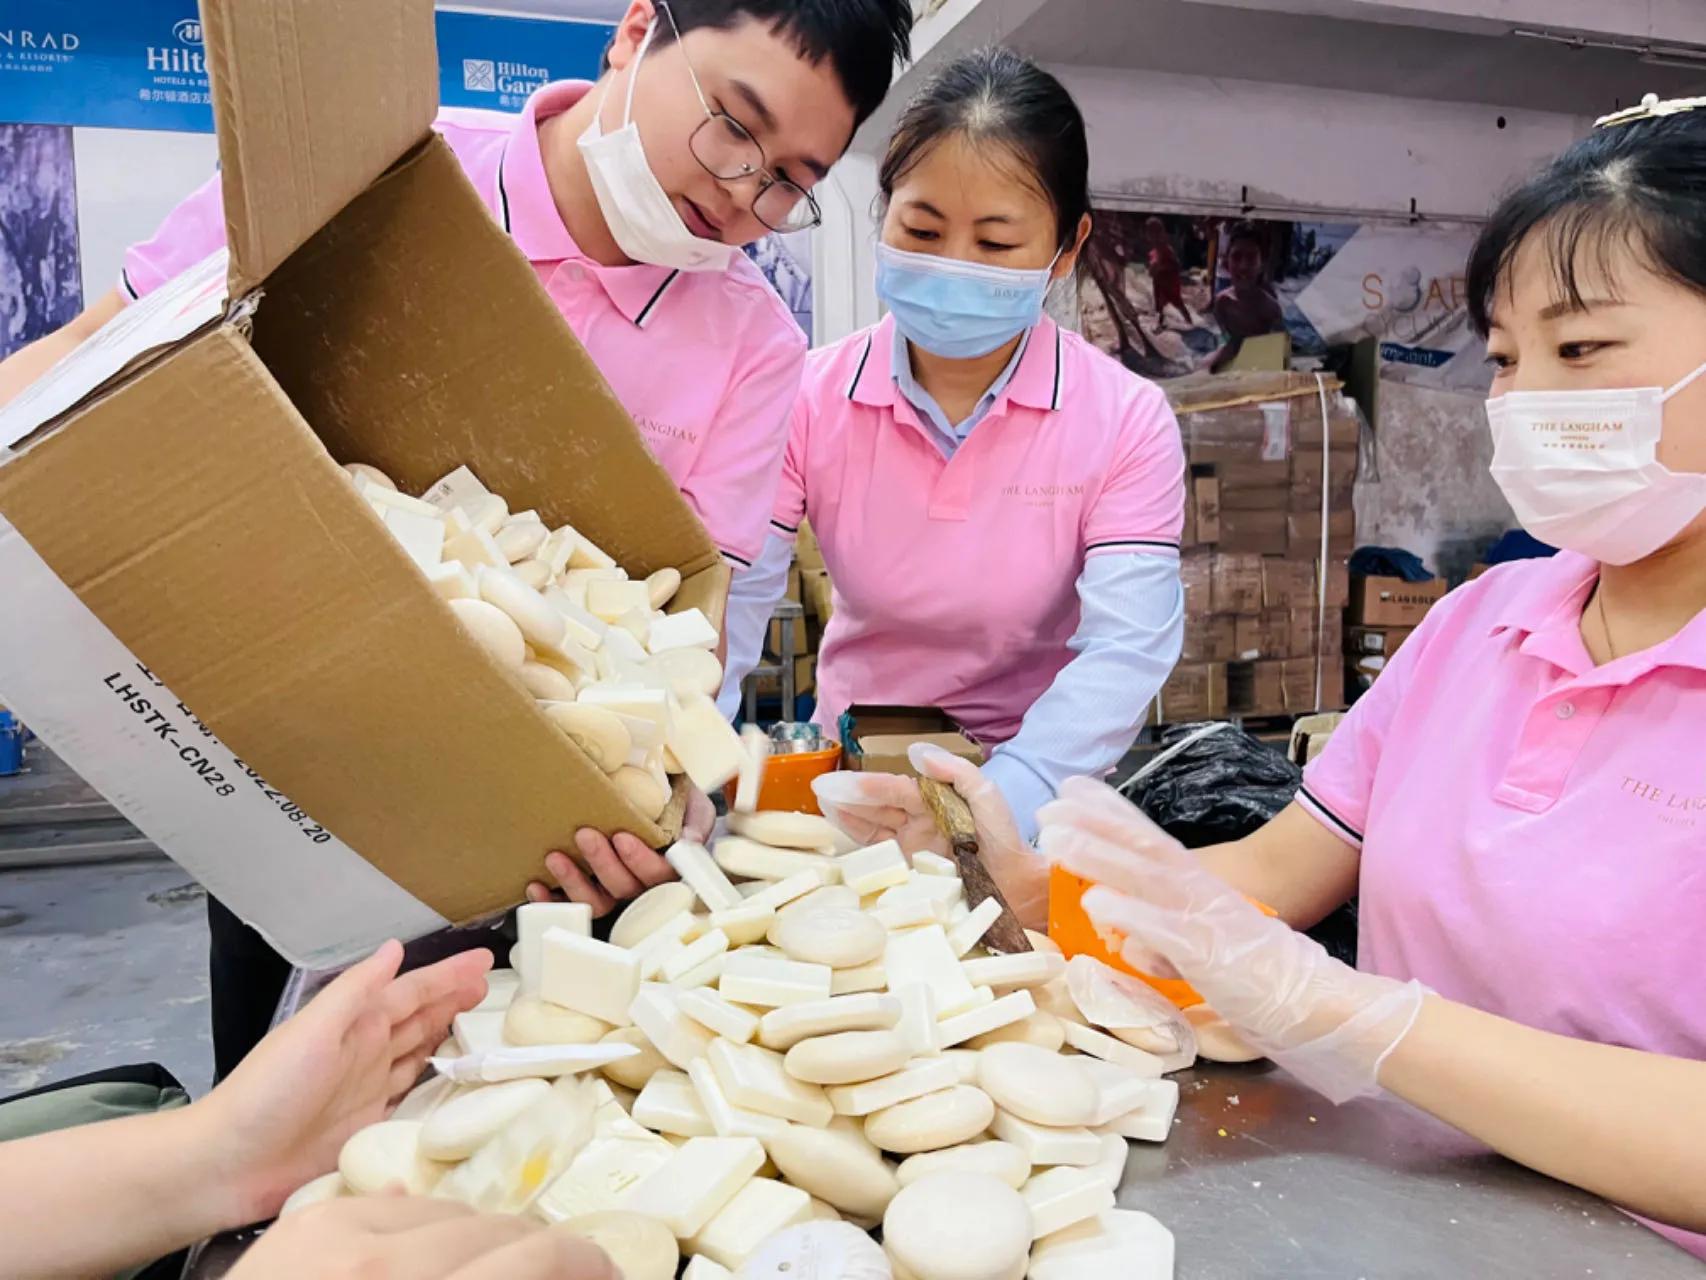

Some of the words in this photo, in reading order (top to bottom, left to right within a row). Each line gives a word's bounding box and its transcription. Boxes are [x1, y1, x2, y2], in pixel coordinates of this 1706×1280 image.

[498, 61, 549, 80] Hilton
[153, 76, 187, 86] HOTELS
[1529, 421, 1557, 432] THE
[1559, 421, 1623, 432] LANGHAM
[103, 671, 236, 797] LHSTK-CN28
[1621, 776, 1663, 801] THE
